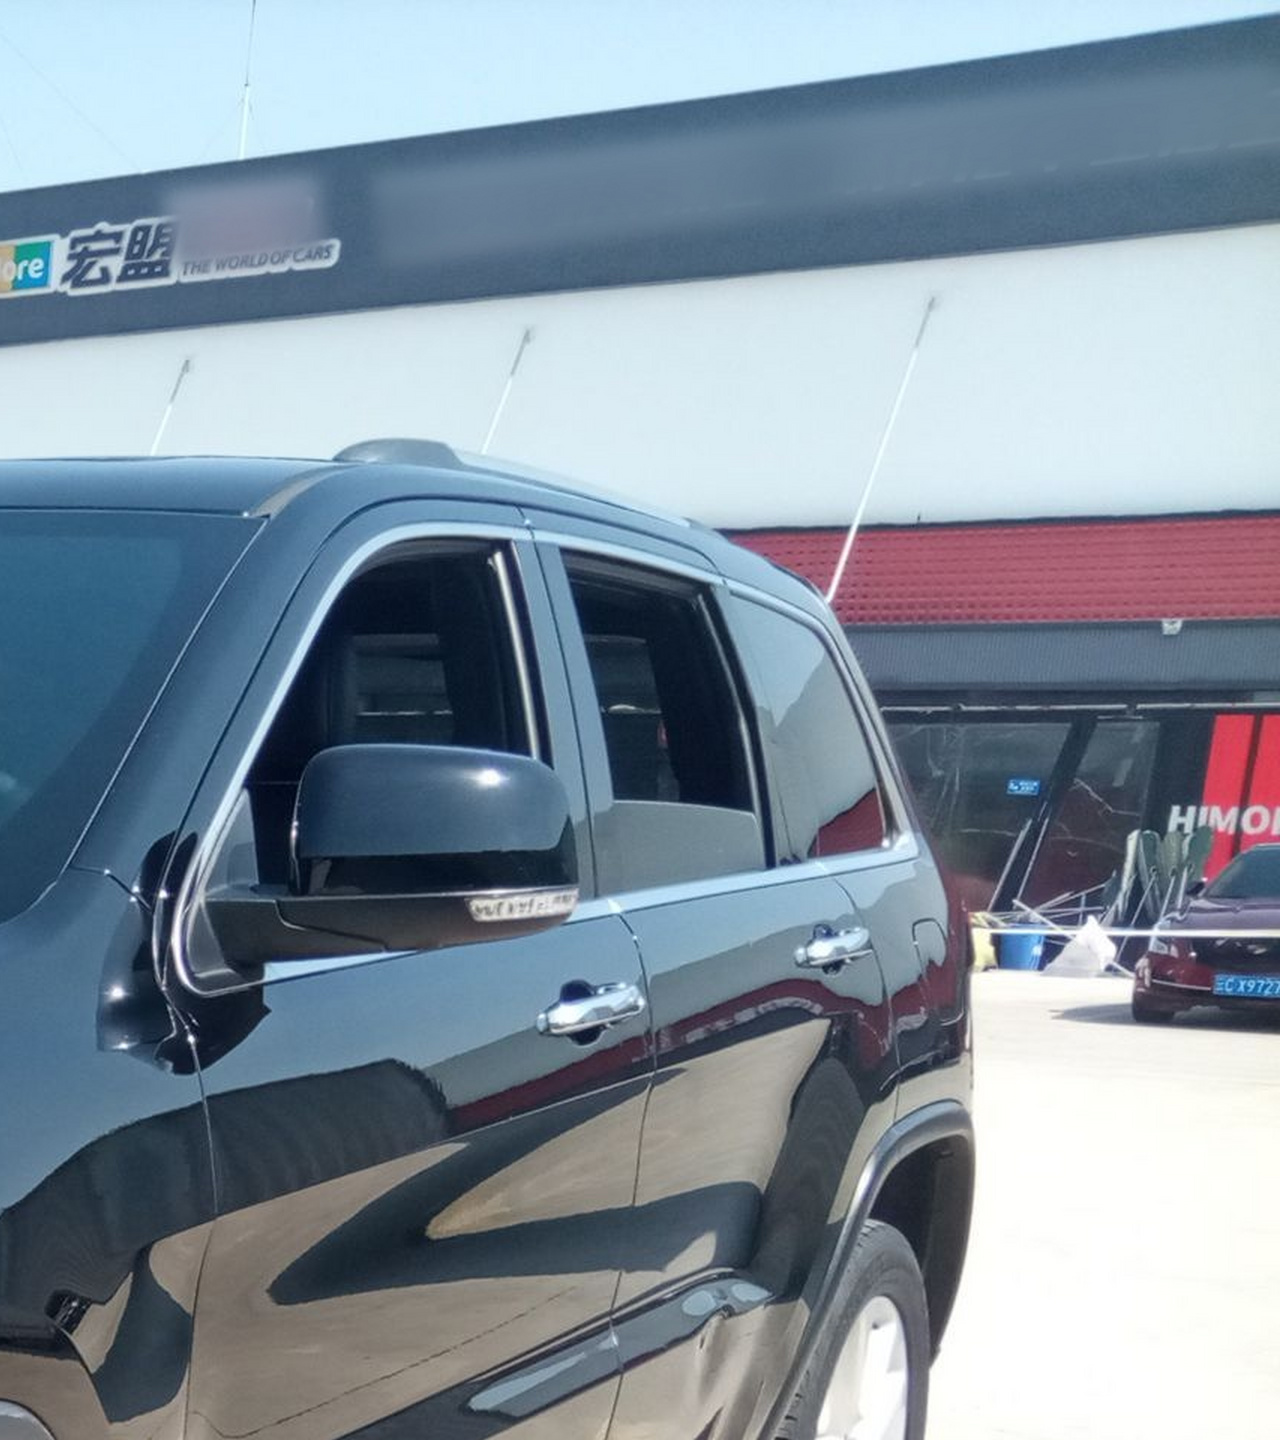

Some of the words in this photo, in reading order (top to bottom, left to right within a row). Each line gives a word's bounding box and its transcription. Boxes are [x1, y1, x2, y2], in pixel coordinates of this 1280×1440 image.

[182, 259, 213, 276] THE
[215, 252, 268, 271] WORLD
[269, 249, 291, 265] OF
[292, 243, 335, 262] CARS
[1167, 804, 1280, 836] HIMO
